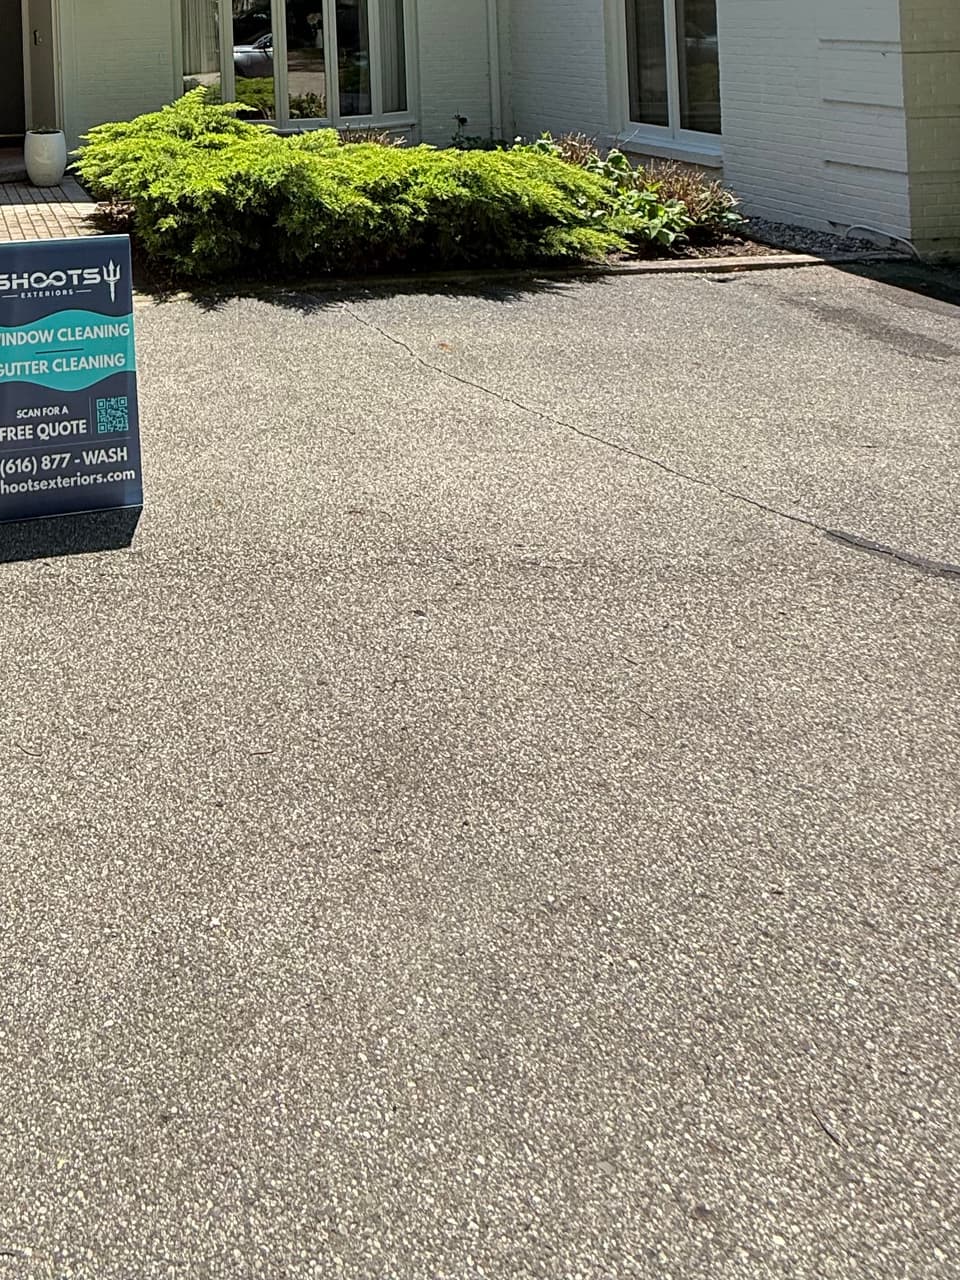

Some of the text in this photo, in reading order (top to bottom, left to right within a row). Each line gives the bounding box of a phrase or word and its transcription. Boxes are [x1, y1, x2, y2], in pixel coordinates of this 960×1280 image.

[21, 290, 73, 298] EXTERIORS
[57, 324, 129, 341] CLEANING
[52, 353, 125, 372] CLEANING
[16, 406, 68, 418] SCAN FOR A
[0, 420, 87, 442] FREE QUOTE
[0, 457, 37, 478] (616)
[41, 453, 71, 470] 877
[82, 447, 127, 465] WASH
